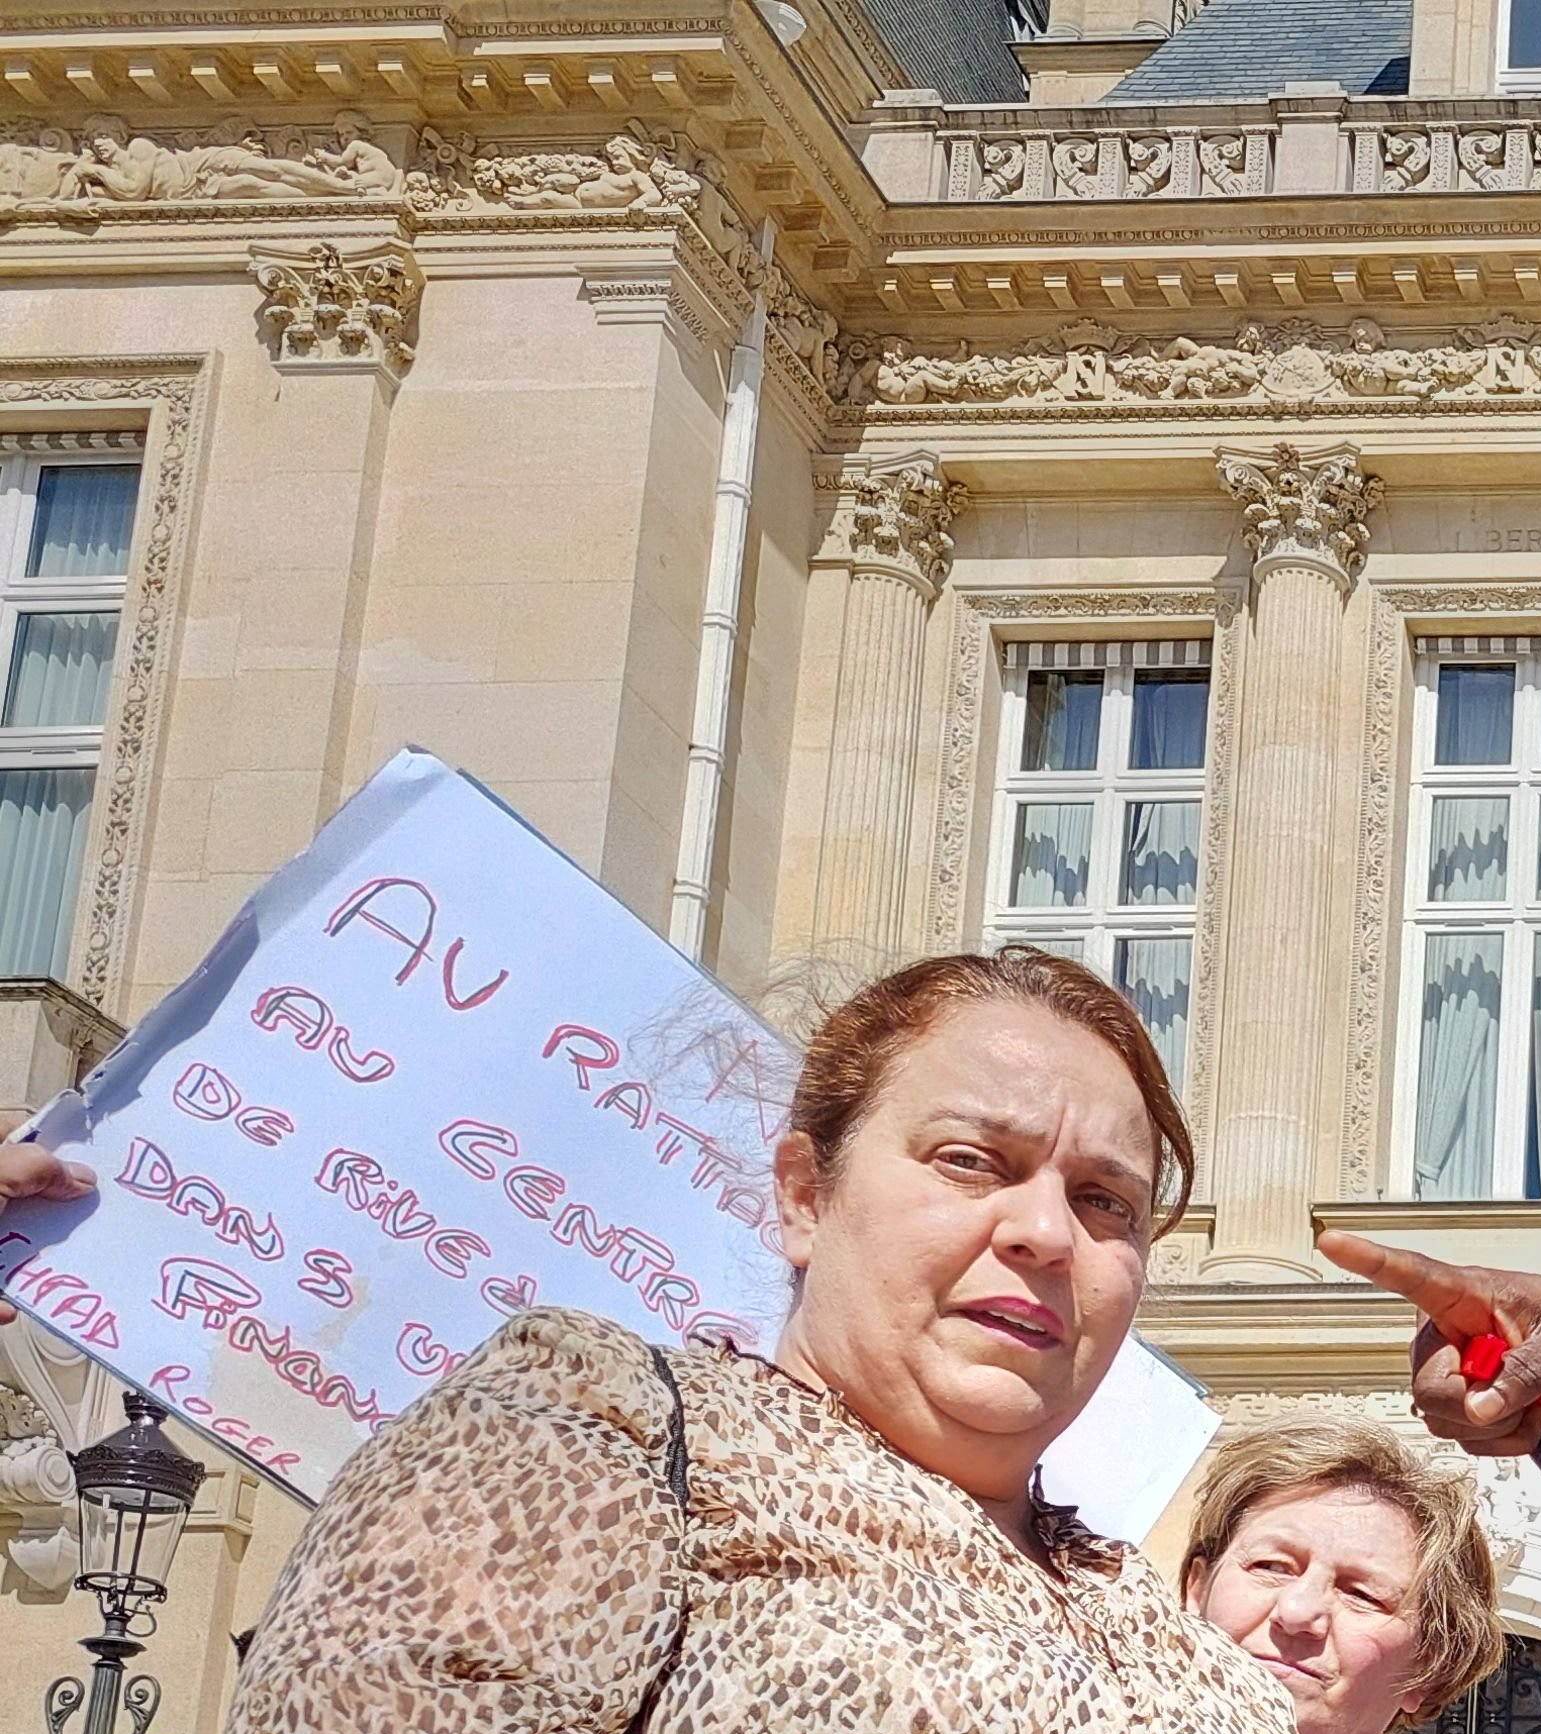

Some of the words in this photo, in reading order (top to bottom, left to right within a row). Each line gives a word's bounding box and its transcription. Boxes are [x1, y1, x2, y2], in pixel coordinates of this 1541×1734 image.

[323, 878, 508, 1012] AU
[251, 986, 394, 1083] AU
[173, 1062, 294, 1146] DE
[147, 1364, 302, 1475] ROGER
